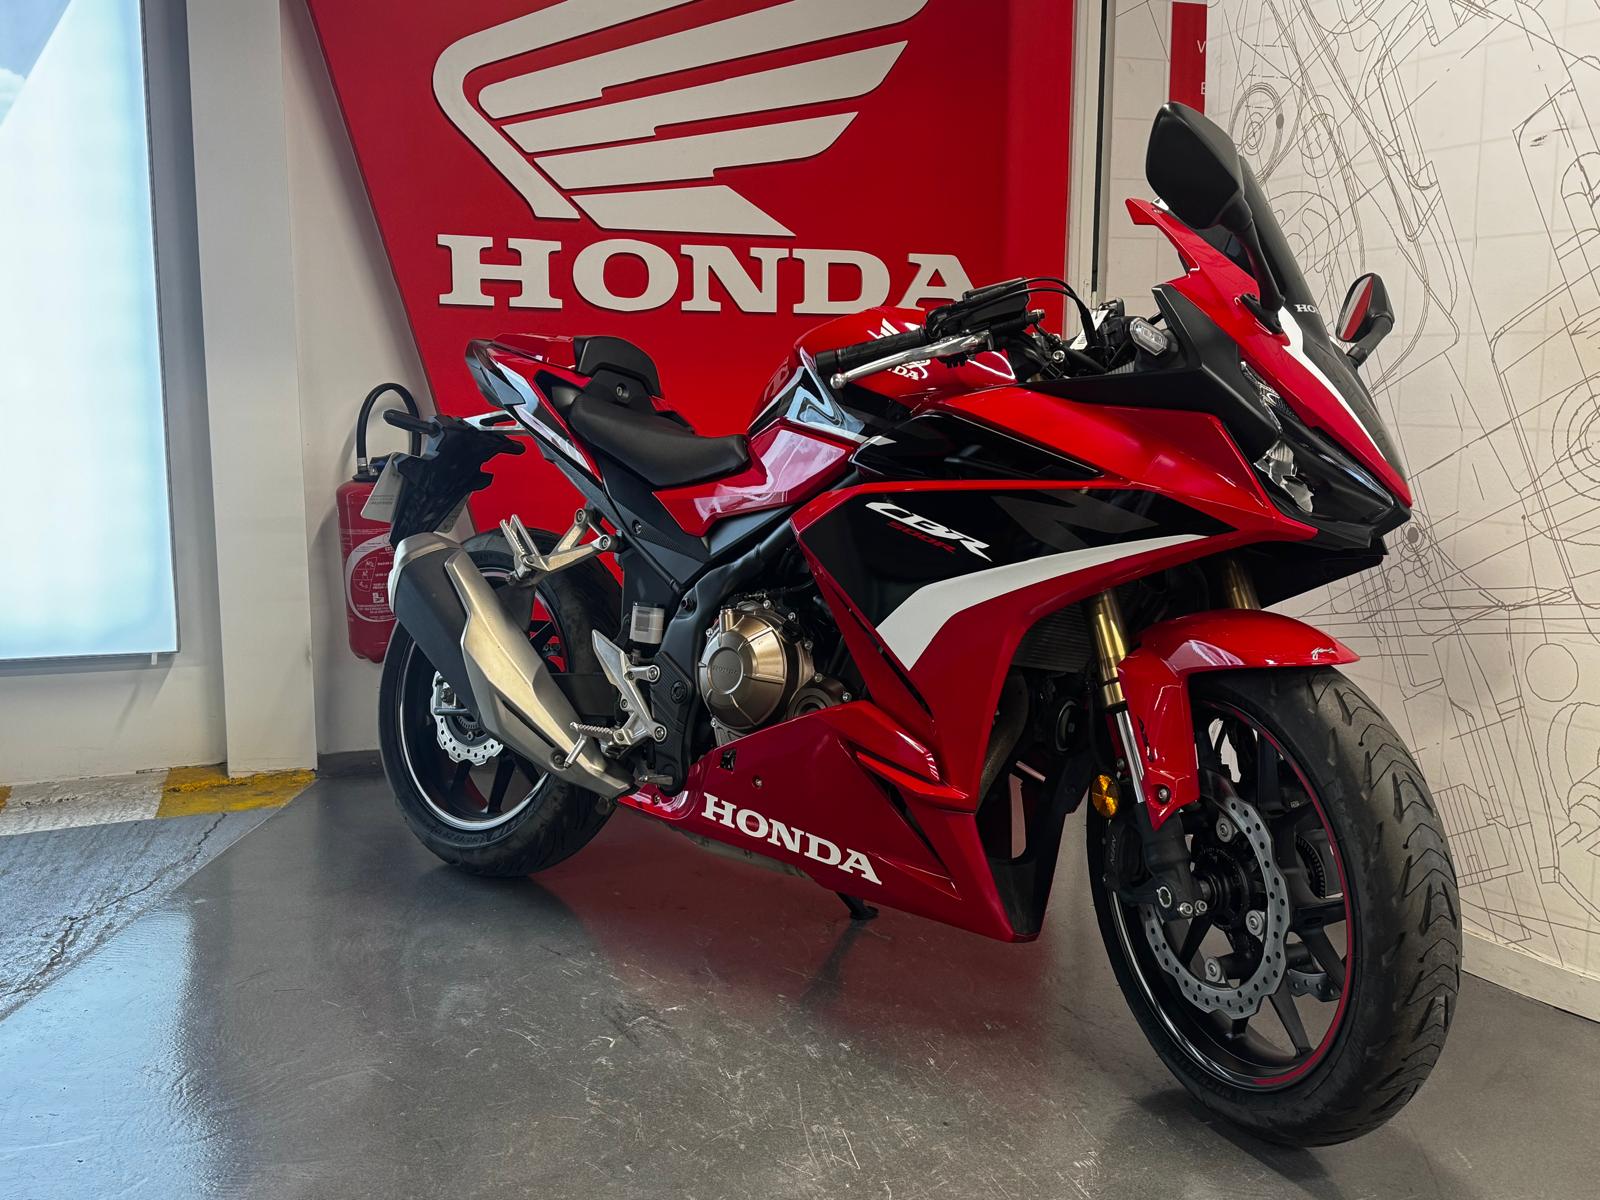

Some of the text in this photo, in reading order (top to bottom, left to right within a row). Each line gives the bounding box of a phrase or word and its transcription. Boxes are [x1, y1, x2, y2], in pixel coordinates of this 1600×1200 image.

[437, 234, 976, 315] HONDA
[865, 501, 993, 562] CBR
[701, 791, 882, 885] HONDA
